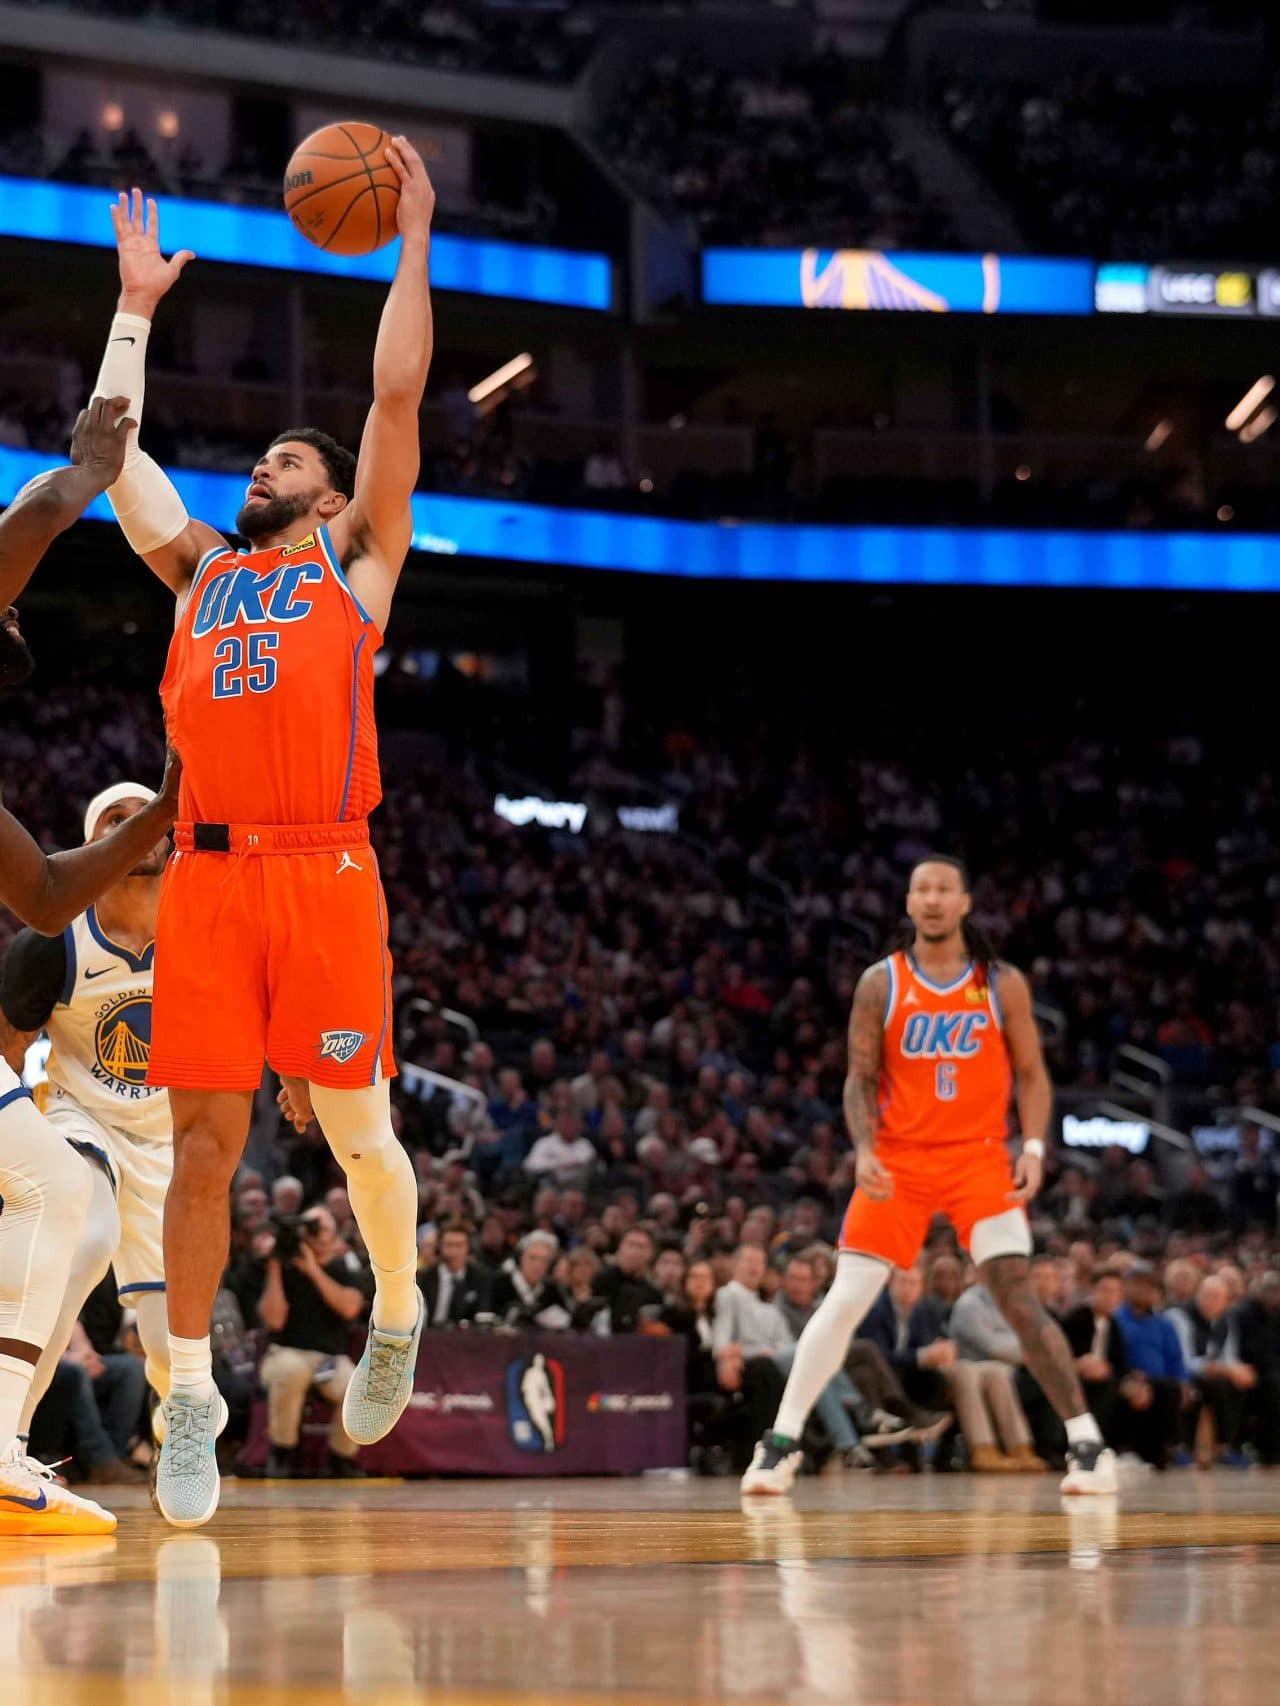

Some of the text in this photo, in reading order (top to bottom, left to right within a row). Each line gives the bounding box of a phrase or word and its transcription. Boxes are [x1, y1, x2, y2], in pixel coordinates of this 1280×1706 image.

[192, 562, 324, 639] OKC
[213, 632, 279, 699] 25
[94, 988, 146, 1018] GOLDEN
[321, 1036, 354, 1055] OKC
[900, 1011, 988, 1059] OKC
[935, 1062, 957, 1101] 6
